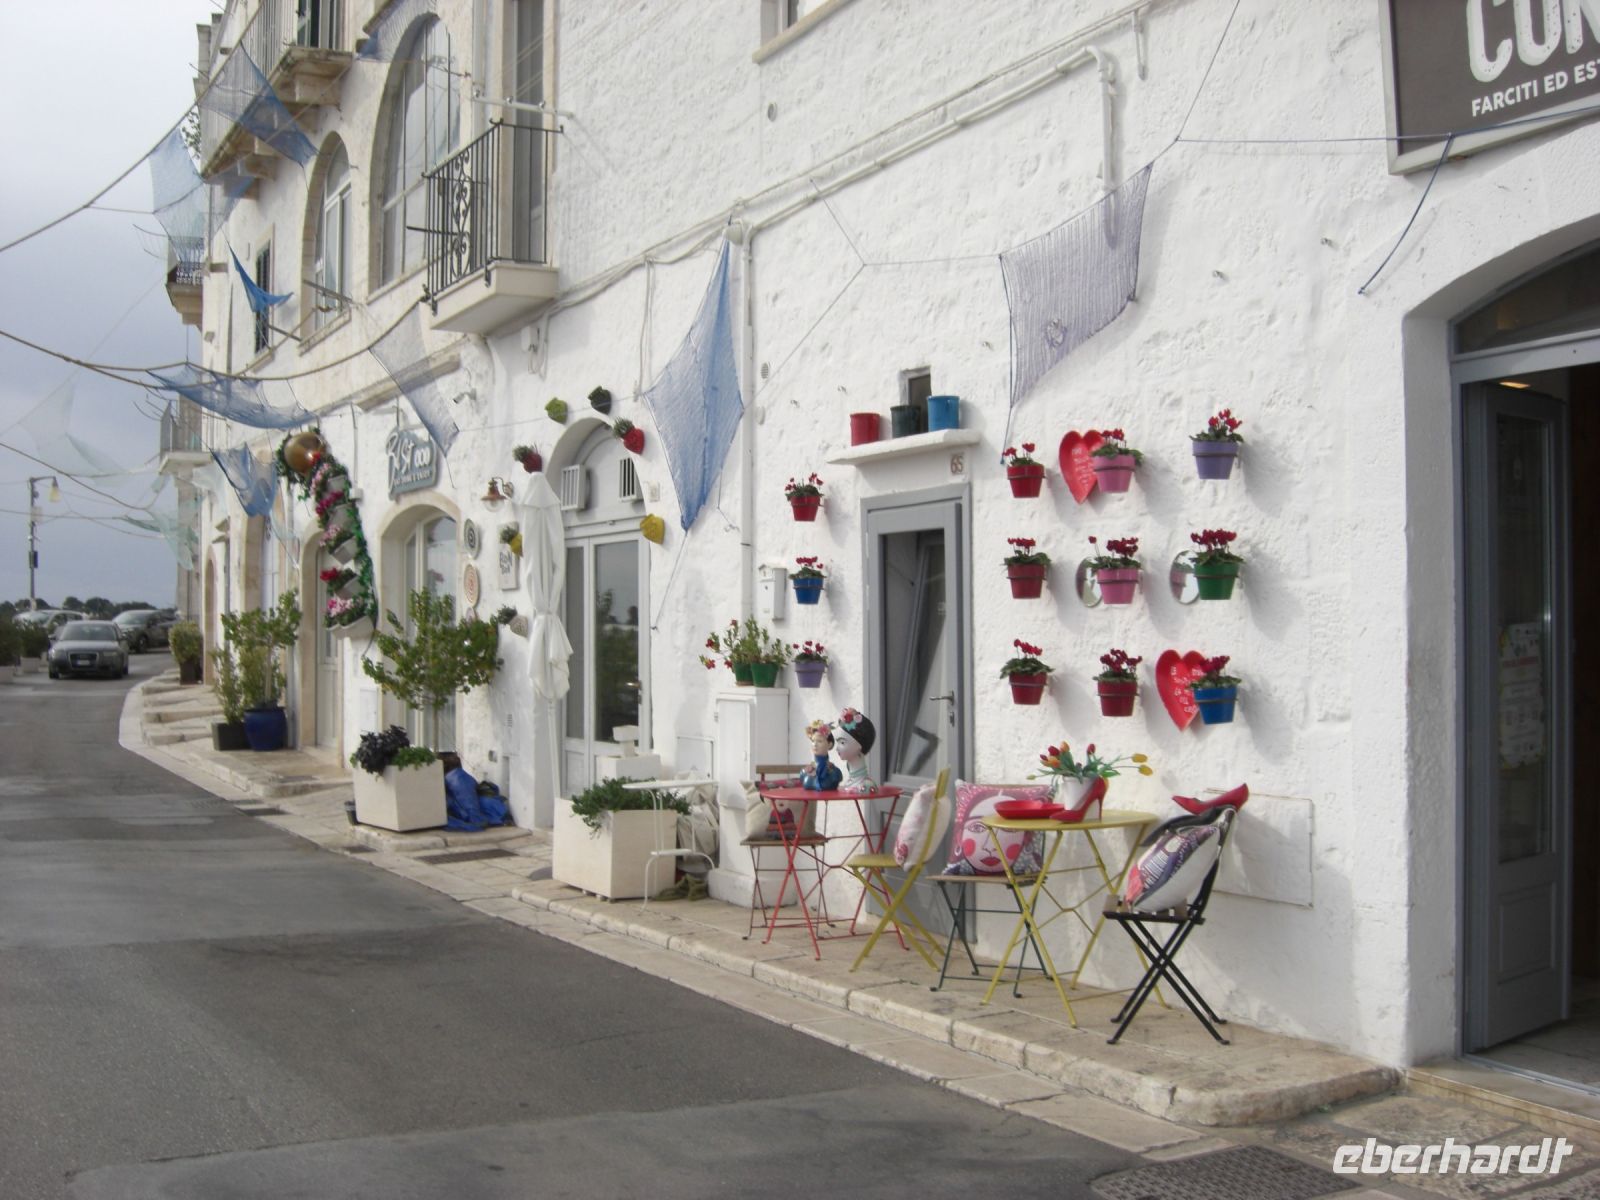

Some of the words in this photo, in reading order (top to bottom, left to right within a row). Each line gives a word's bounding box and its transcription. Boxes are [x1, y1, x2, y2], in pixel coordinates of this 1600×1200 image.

[1472, 79, 1538, 117] FARCITI
[1544, 71, 1568, 94] ED
[1574, 58, 1600, 84] ES
